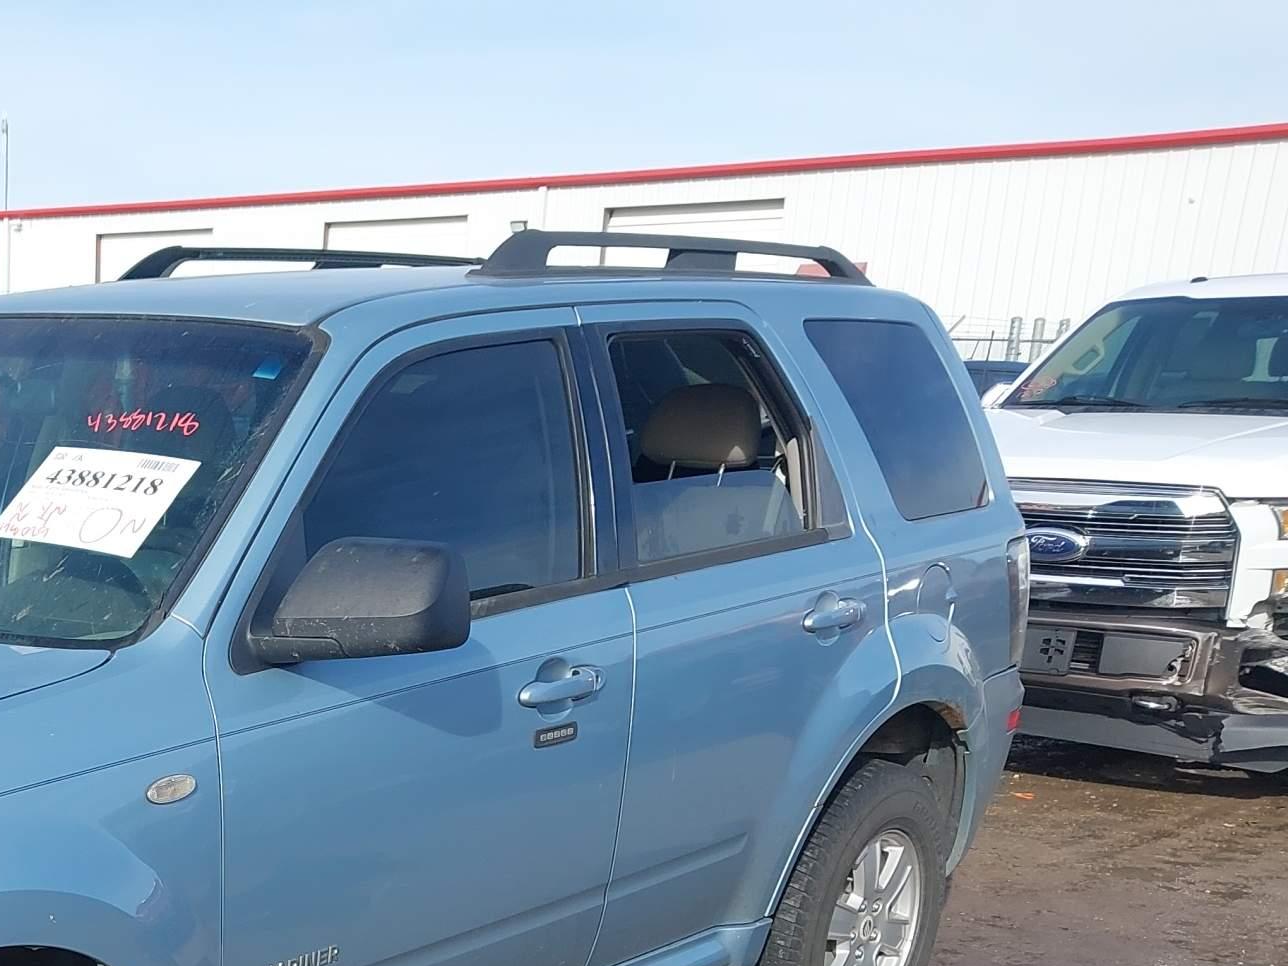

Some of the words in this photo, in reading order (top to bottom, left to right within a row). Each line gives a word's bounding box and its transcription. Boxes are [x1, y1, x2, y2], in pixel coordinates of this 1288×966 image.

[87, 408, 200, 436] 43881218
[45, 468, 164, 496] 43881218
[1030, 535, 1067, 553] Ford
